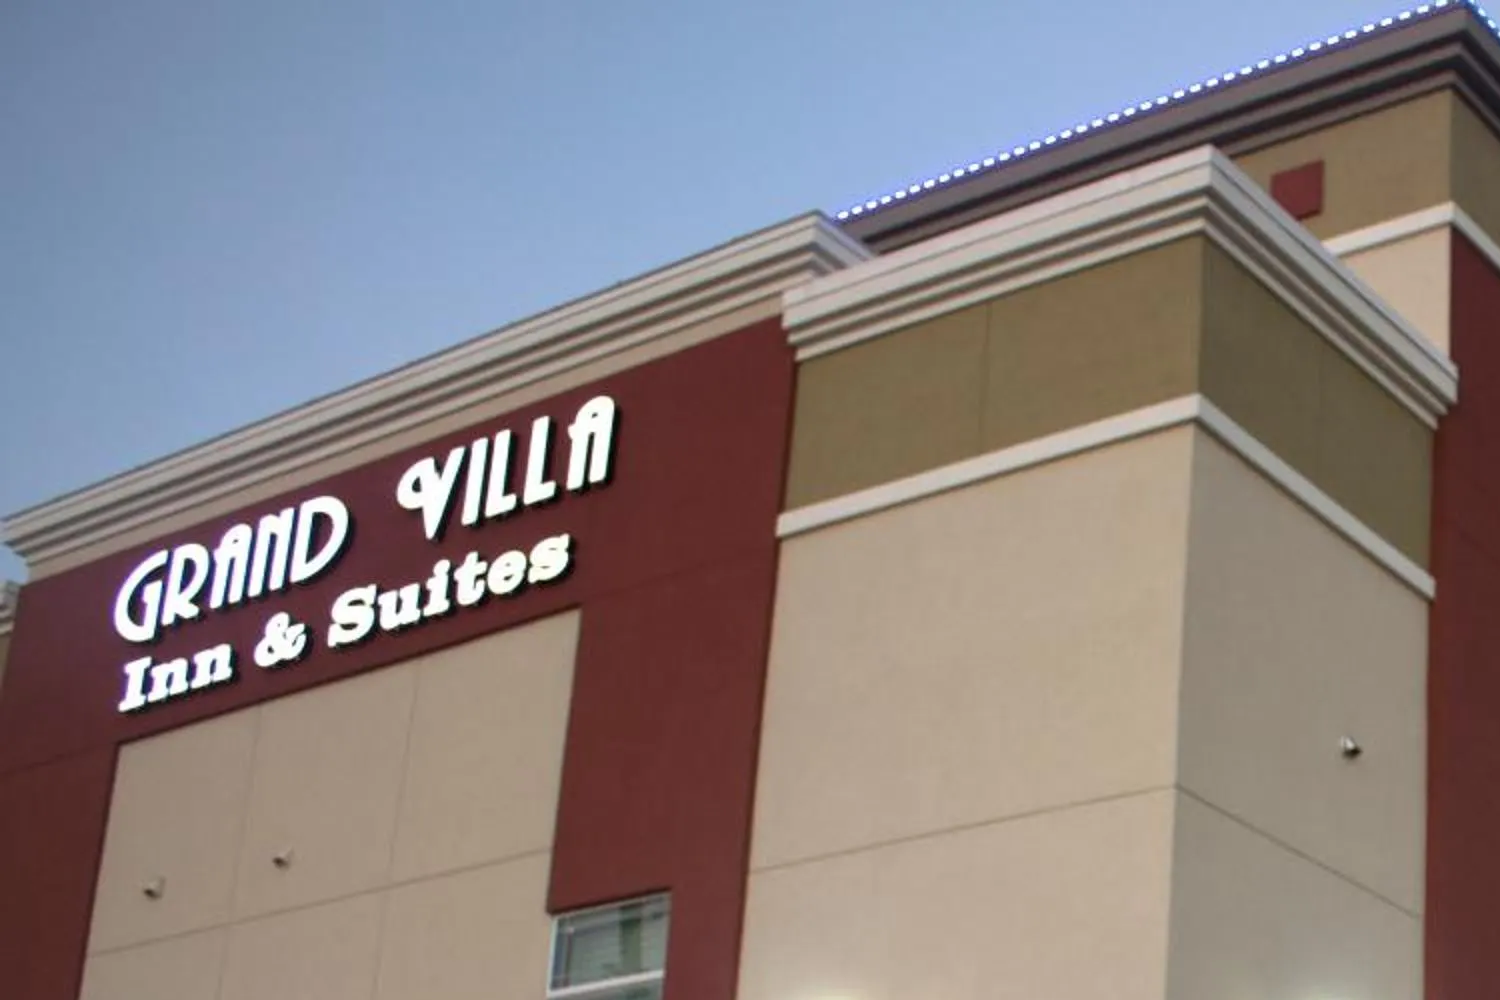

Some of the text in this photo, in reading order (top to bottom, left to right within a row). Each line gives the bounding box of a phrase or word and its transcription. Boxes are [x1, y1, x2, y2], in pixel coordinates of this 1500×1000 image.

[114, 395, 615, 642] GRAND VILLA
[118, 533, 571, 712] Inn & Suites
